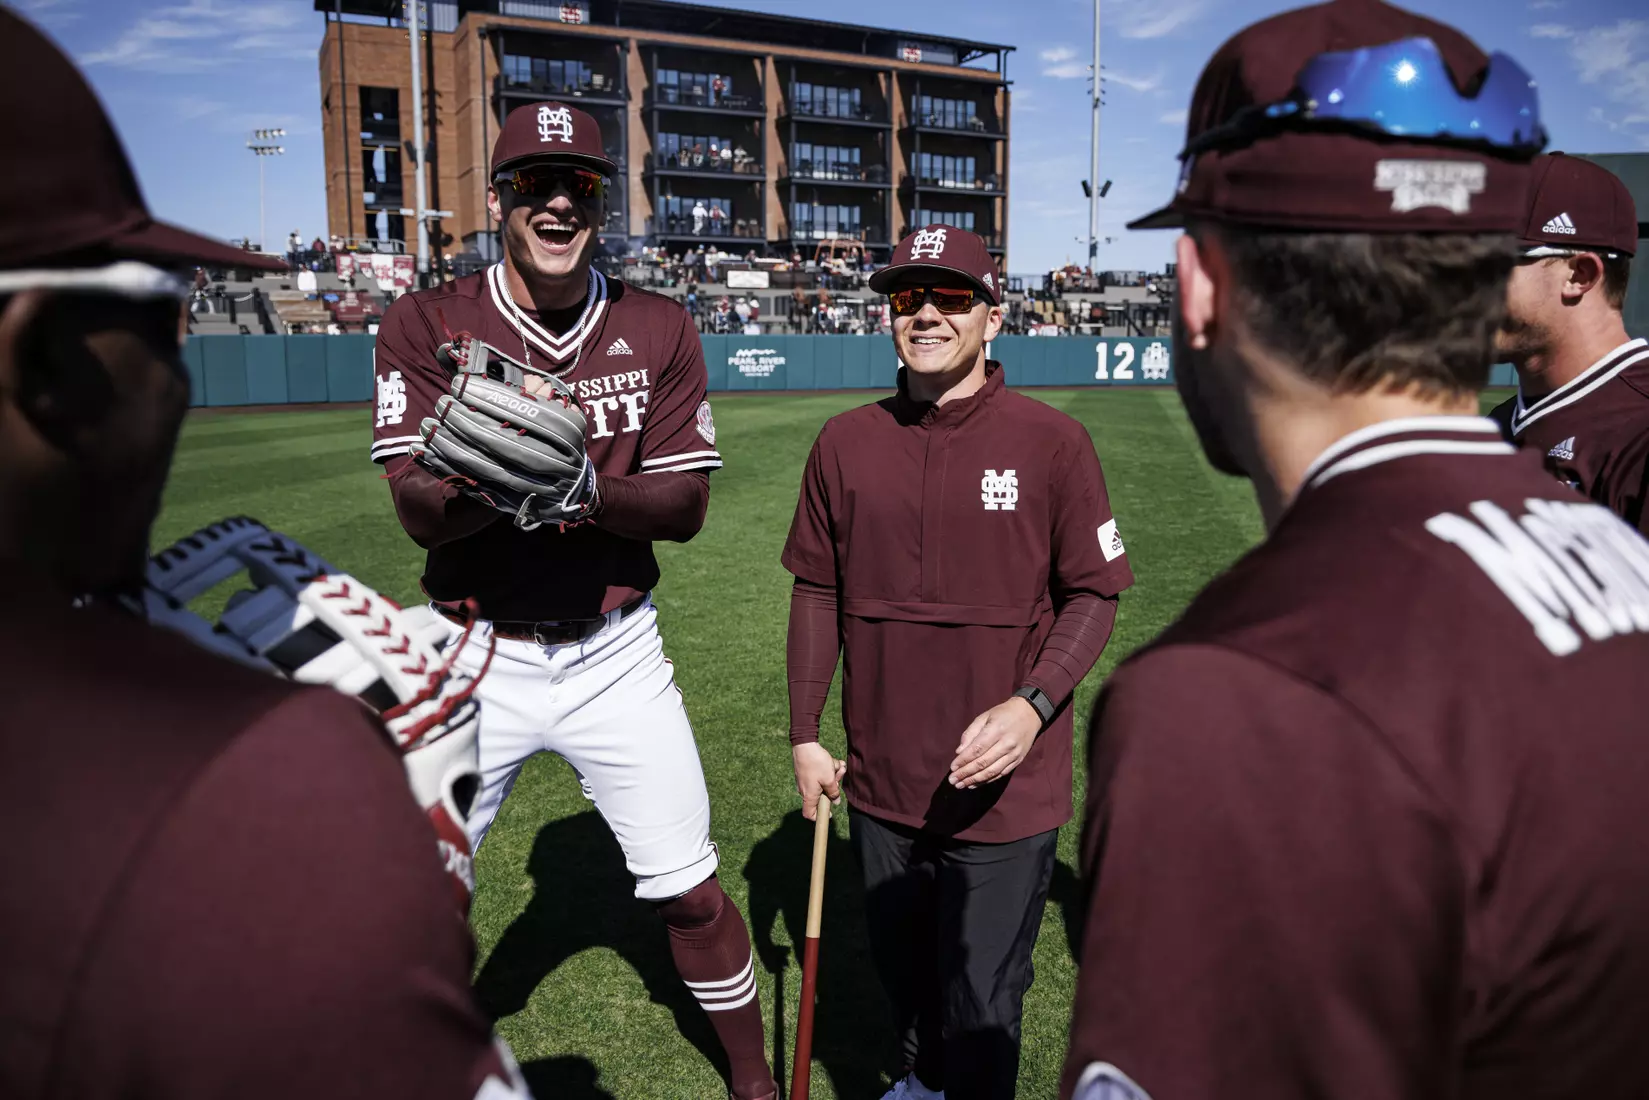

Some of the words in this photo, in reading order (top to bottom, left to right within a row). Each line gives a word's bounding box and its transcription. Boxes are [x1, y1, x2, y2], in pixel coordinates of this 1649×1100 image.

[1542, 225, 1576, 235] adidas
[728, 357, 757, 365] PEARL
[759, 356, 786, 365] RIVER
[1095, 342, 1135, 380] 12
[485, 389, 540, 419] A2000
